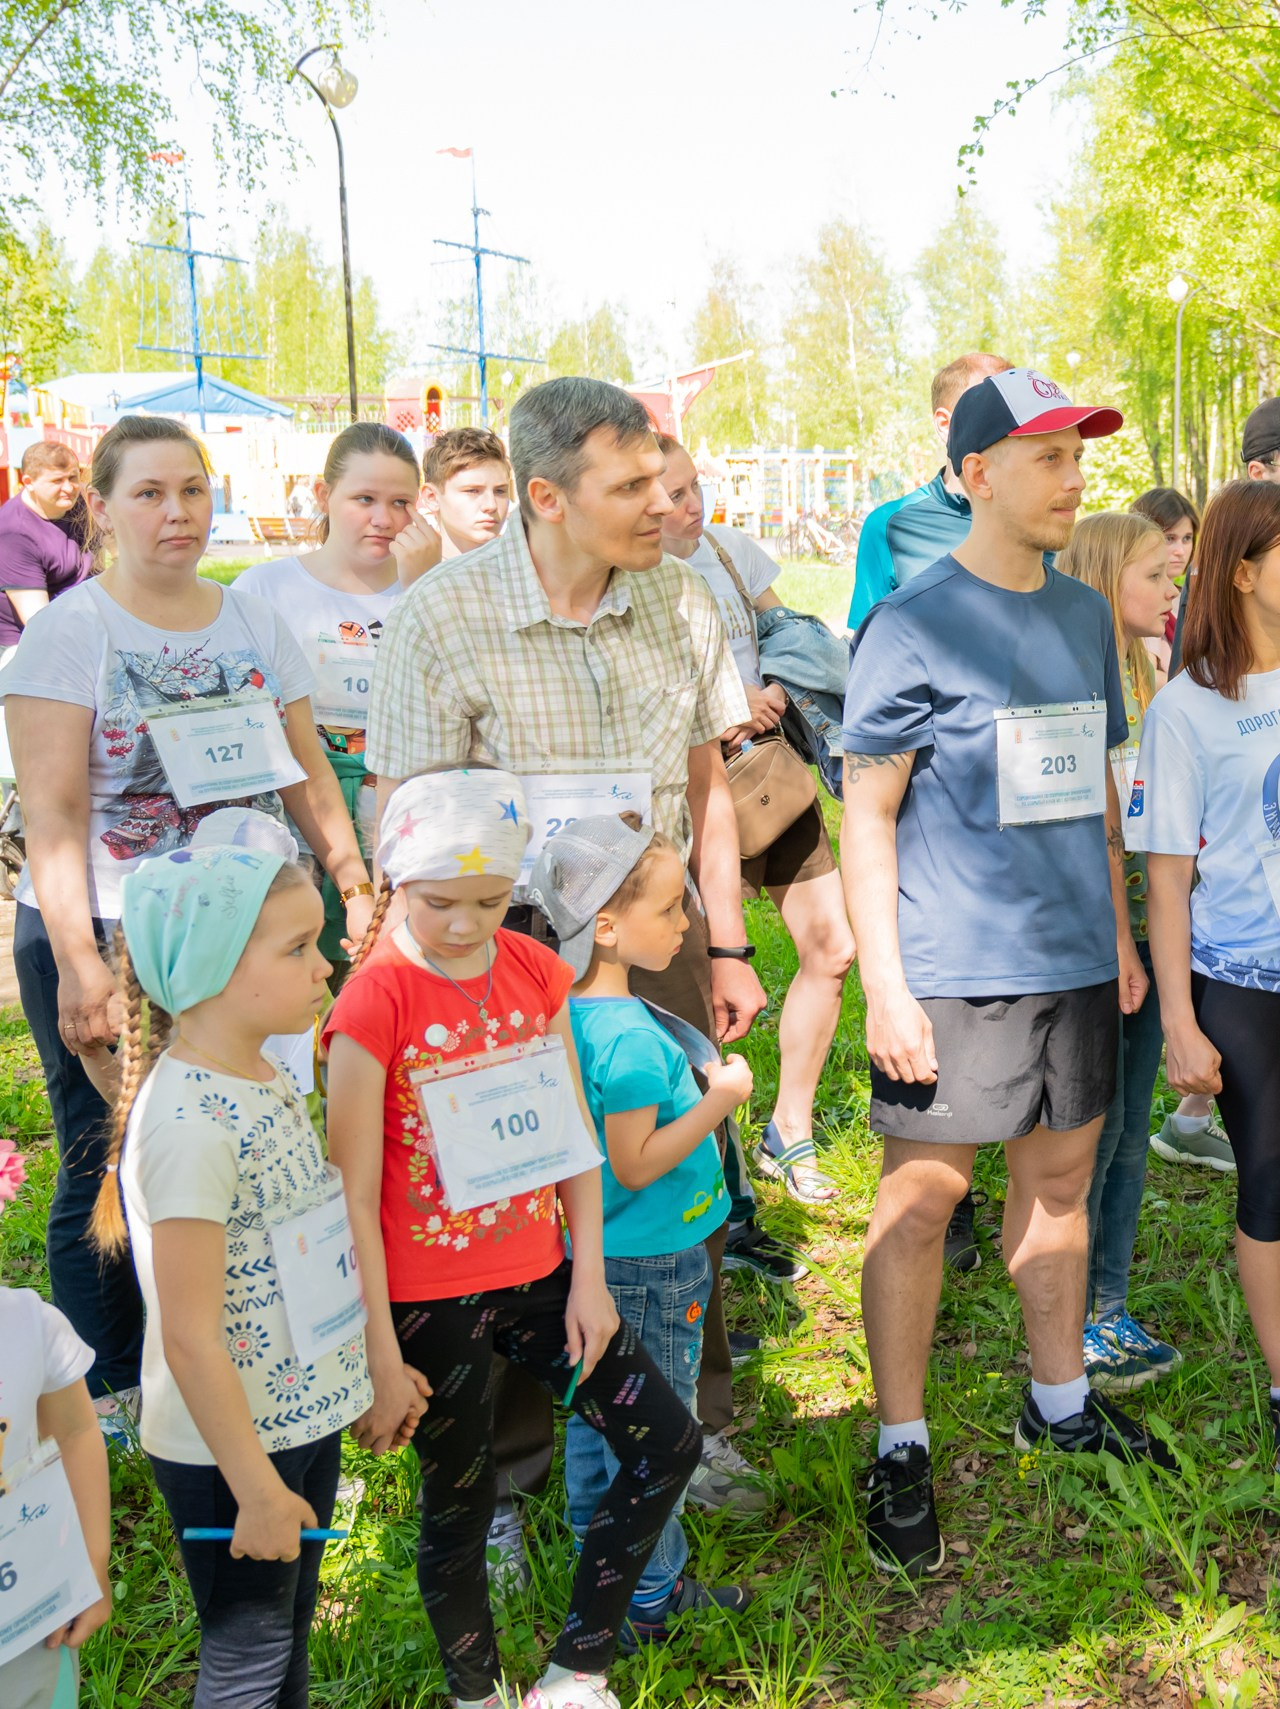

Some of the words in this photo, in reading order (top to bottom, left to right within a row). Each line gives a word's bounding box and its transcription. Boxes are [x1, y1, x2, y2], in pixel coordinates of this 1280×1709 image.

[343, 676, 370, 694] 10
[205, 742, 244, 764] 127
[1041, 754, 1077, 776] 203
[491, 1109, 540, 1141] 100
[336, 1244, 357, 1279] 10
[892, 1450, 907, 1459] FILA
